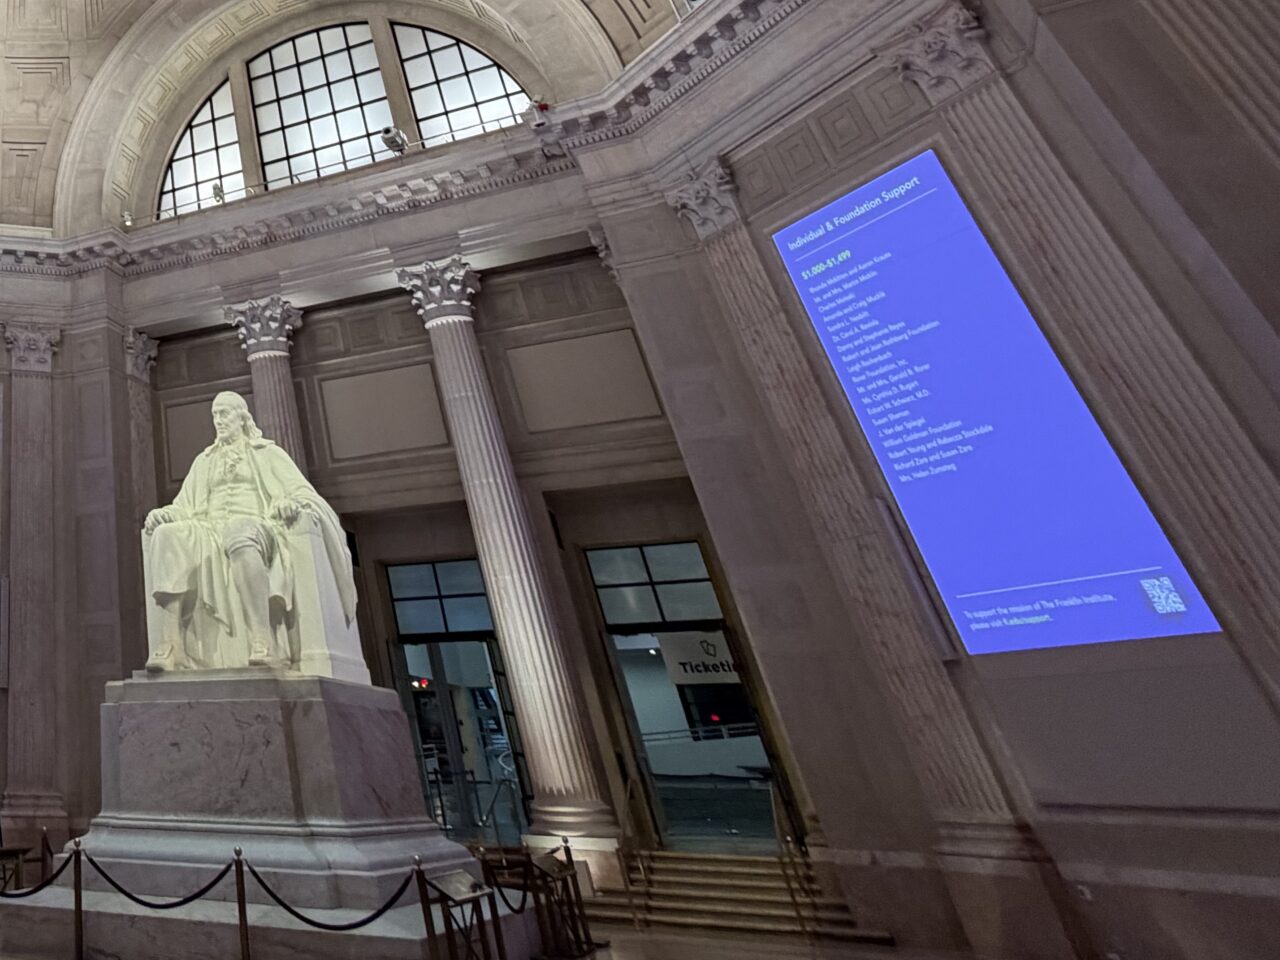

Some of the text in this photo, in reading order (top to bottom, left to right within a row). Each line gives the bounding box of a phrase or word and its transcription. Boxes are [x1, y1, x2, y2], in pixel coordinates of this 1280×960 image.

[787, 176, 920, 251] Individual & Foundation Support
[841, 351, 859, 362] Robert
[906, 320, 940, 336] Foundation
[927, 419, 962, 434] Foundation
[887, 449, 908, 459] Robert
